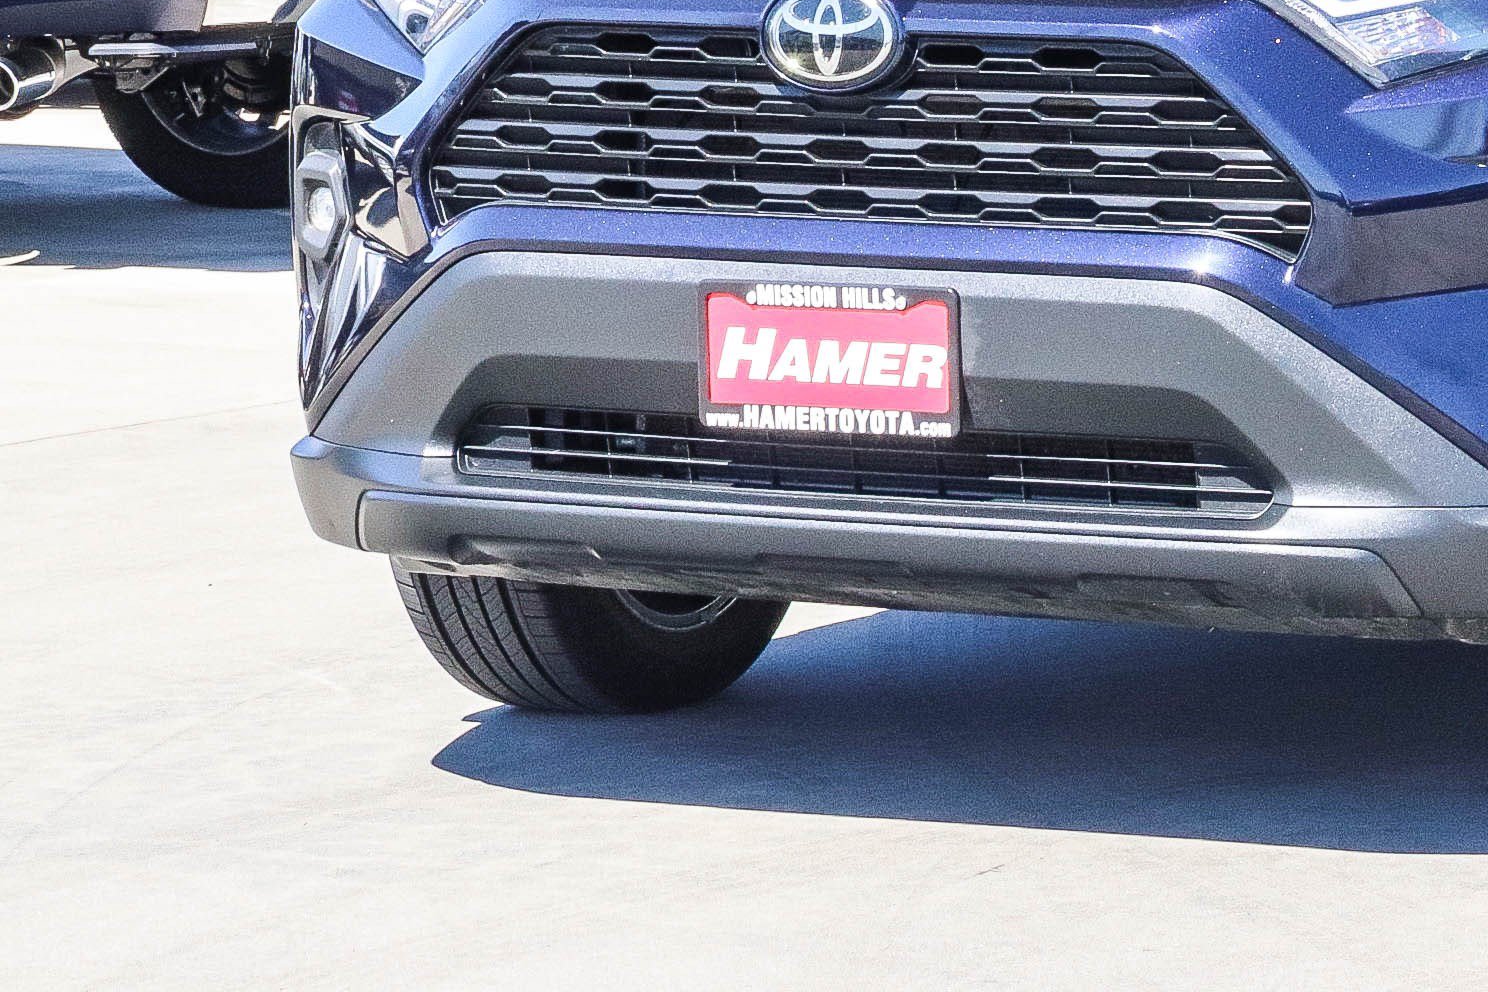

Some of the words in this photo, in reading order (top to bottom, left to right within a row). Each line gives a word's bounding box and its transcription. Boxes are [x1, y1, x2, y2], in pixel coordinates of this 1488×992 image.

[755, 284, 836, 308] MISSION
[842, 286, 896, 310] HILLS
[717, 326, 948, 389] HAMER
[704, 405, 952, 438] www.HAMERTOYOTA.com
